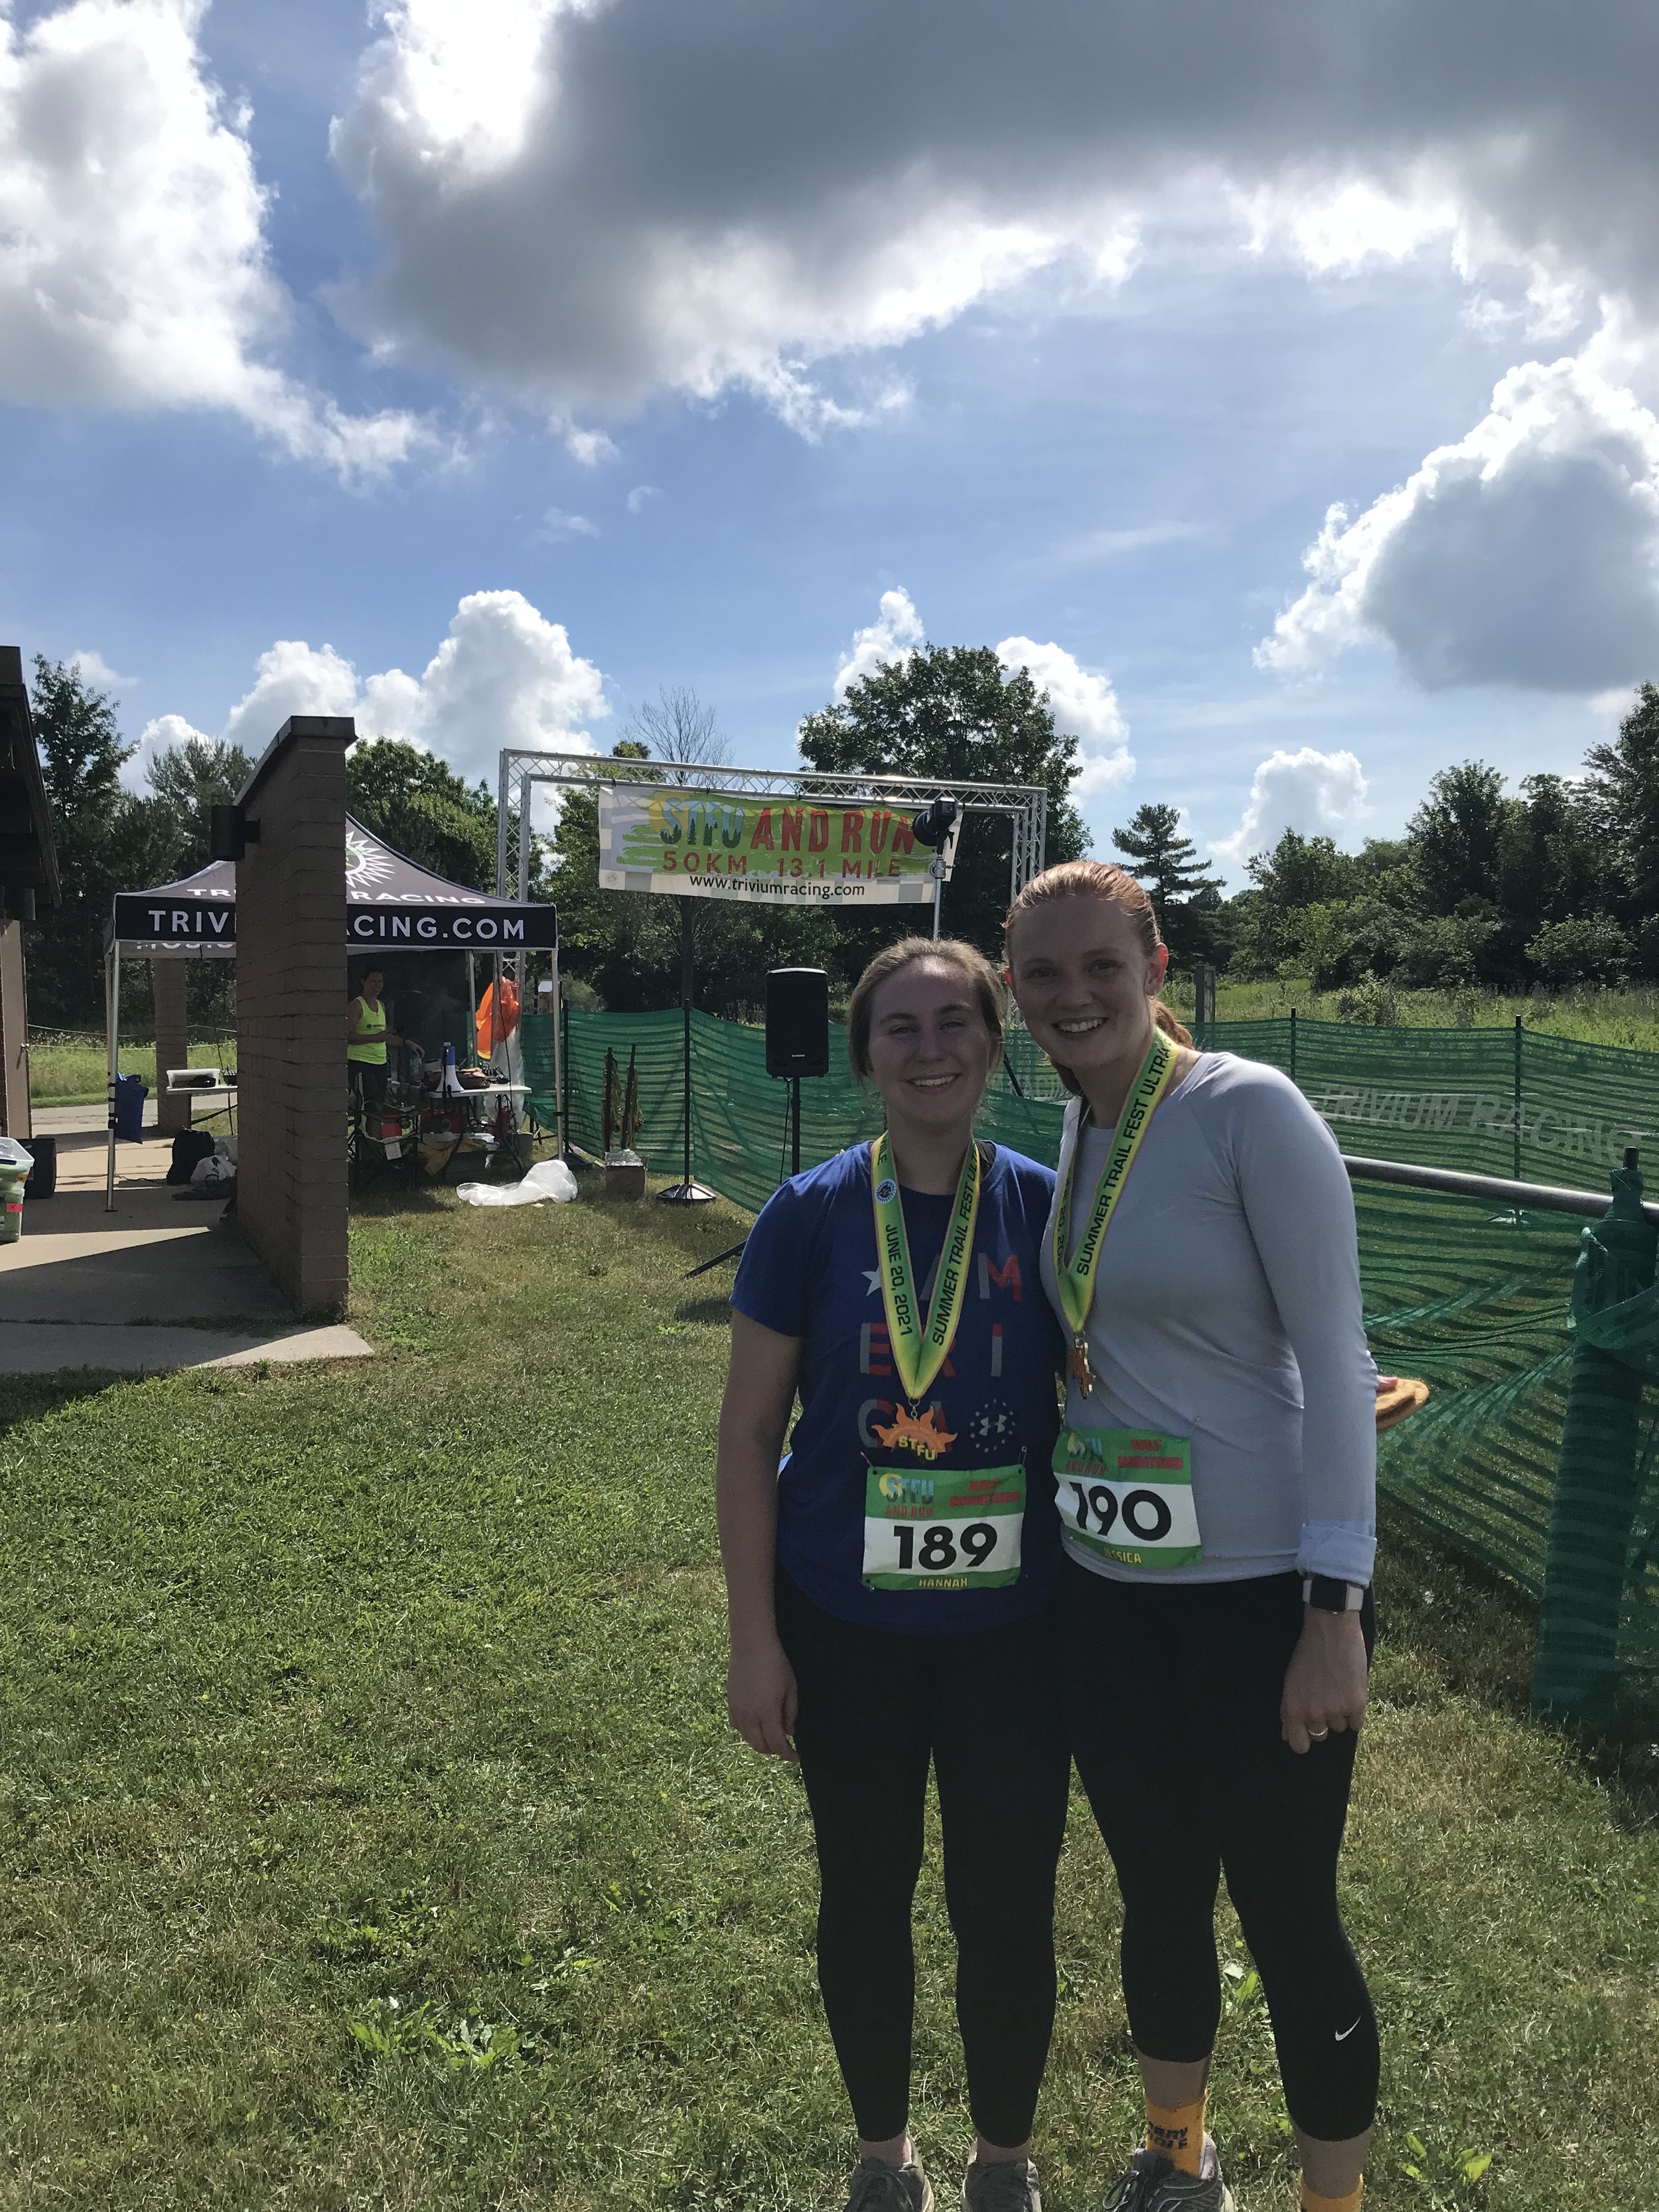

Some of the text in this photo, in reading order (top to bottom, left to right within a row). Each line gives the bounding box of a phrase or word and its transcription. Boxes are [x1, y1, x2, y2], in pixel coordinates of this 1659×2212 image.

[660, 798, 915, 855] STFU AND RUN
[663, 851, 901, 879] 50KM 13.1 MILE
[350, 891, 486, 904] RACING
[689, 875, 865, 899] www.triviumracing.com
[1321, 1082, 1460, 1131] TRIVIUM
[1076, 1048, 1171, 1276] SUMMER TRAIL FEST ULTRA
[885, 1224, 912, 1336] JUNE 20, 2021
[932, 1270, 959, 1347] SUMMER
[949, 1225, 968, 1266] TRAIL
[960, 1181, 974, 1220] FEST
[899, 1436, 936, 1461] STFU
[885, 1476, 934, 1504] STFU
[885, 1505, 907, 1518] AND
[1069, 1482, 1171, 1541] 190
[893, 1522, 998, 1570] 189
[918, 1578, 968, 1587] HANNAH
